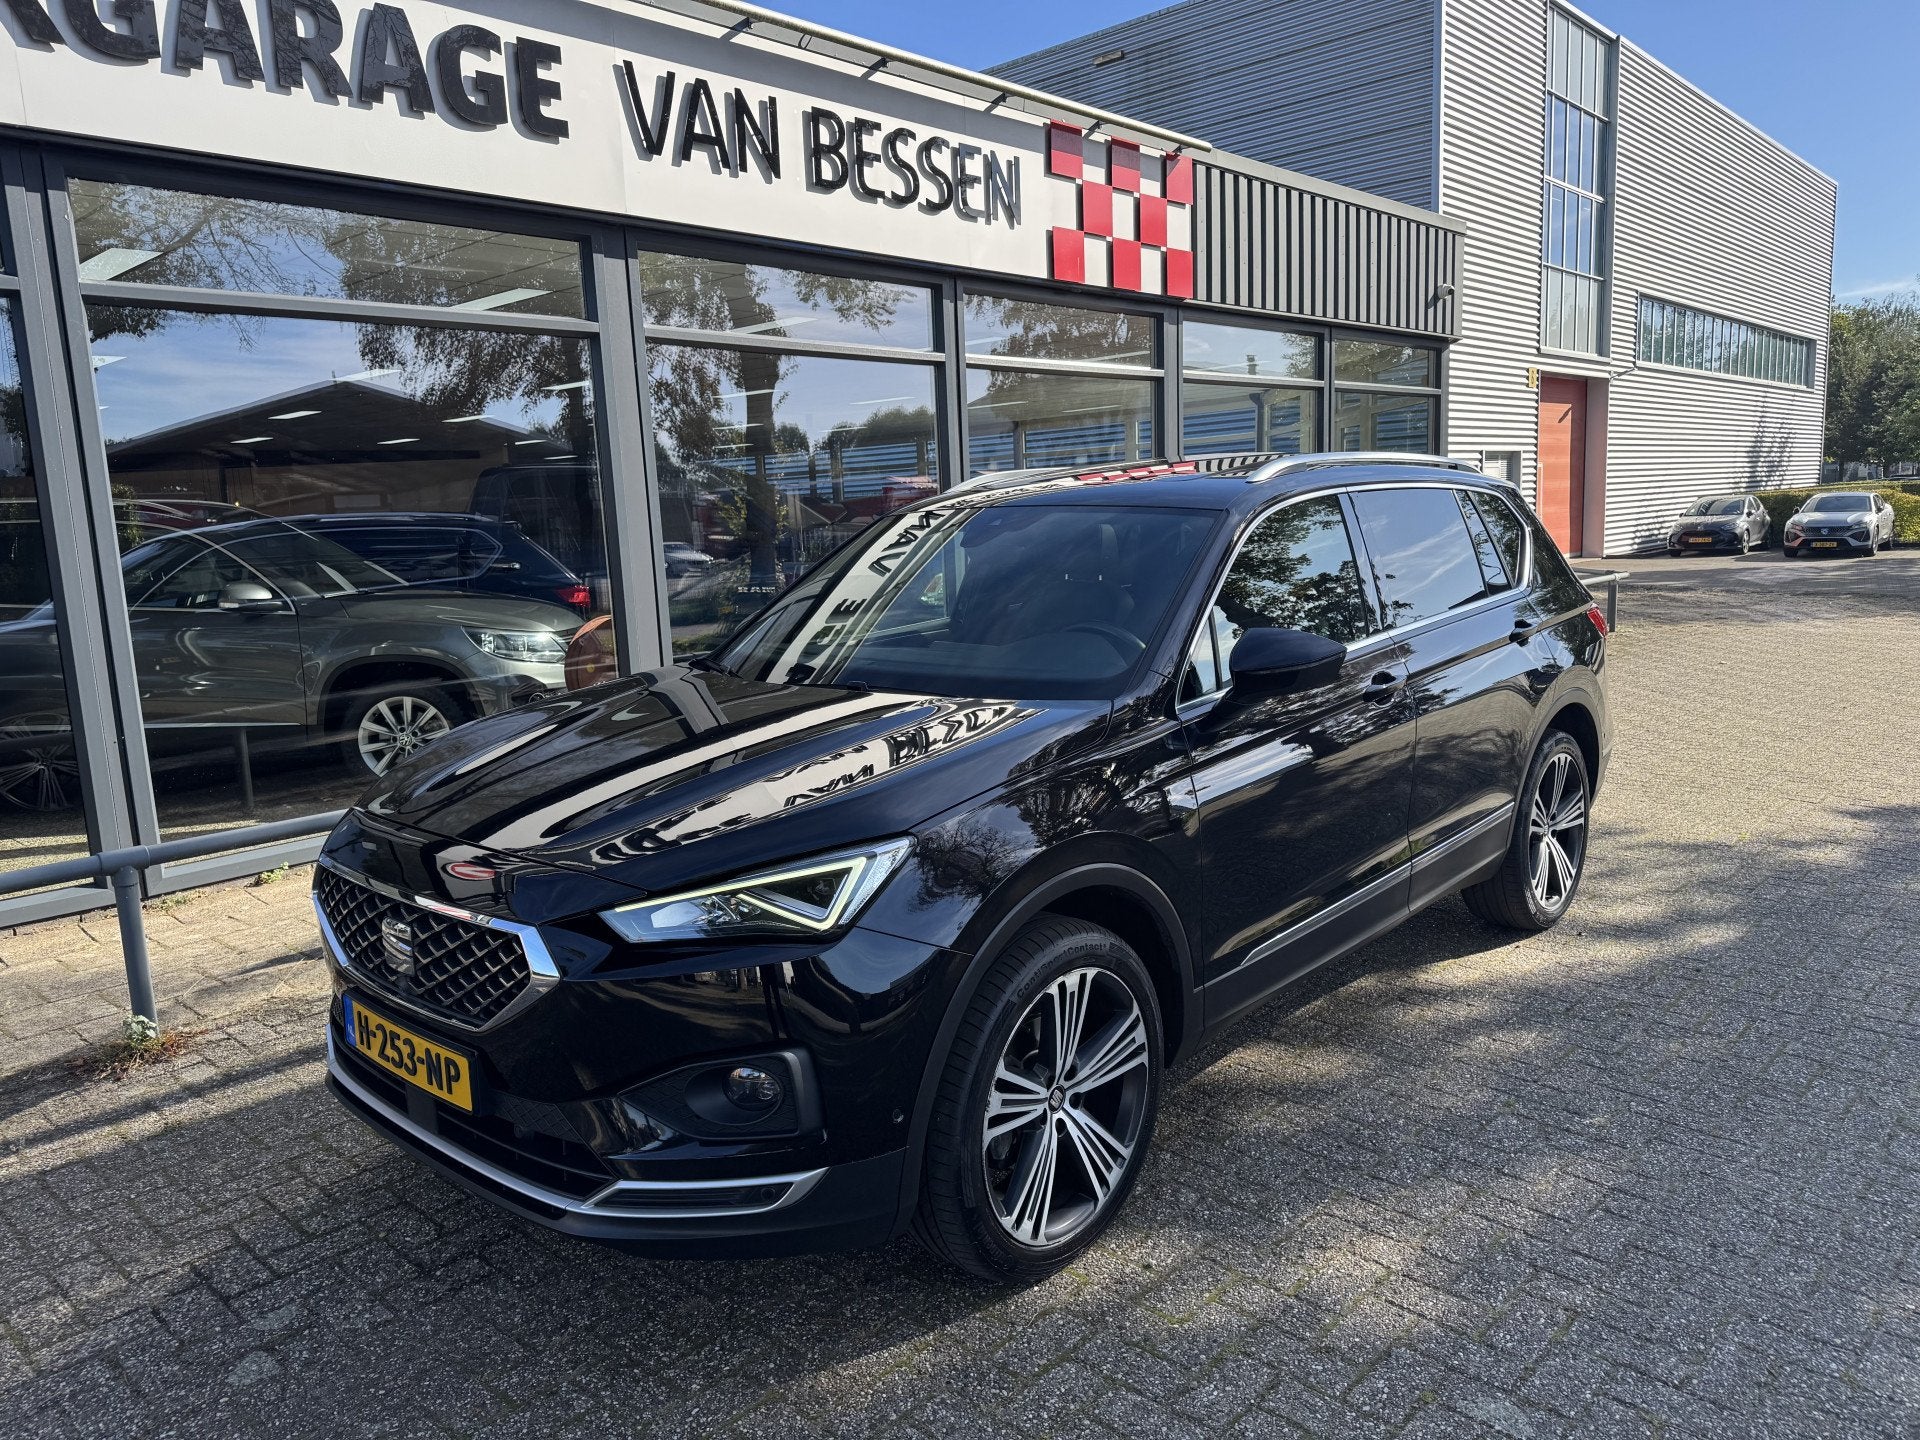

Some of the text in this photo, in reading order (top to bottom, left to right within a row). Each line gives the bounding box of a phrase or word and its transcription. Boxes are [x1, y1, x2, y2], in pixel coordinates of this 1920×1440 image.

[623, 60, 781, 179] VAN
[811, 106, 1021, 225] BESSEN
[357, 1010, 461, 1095] H-253-NP
